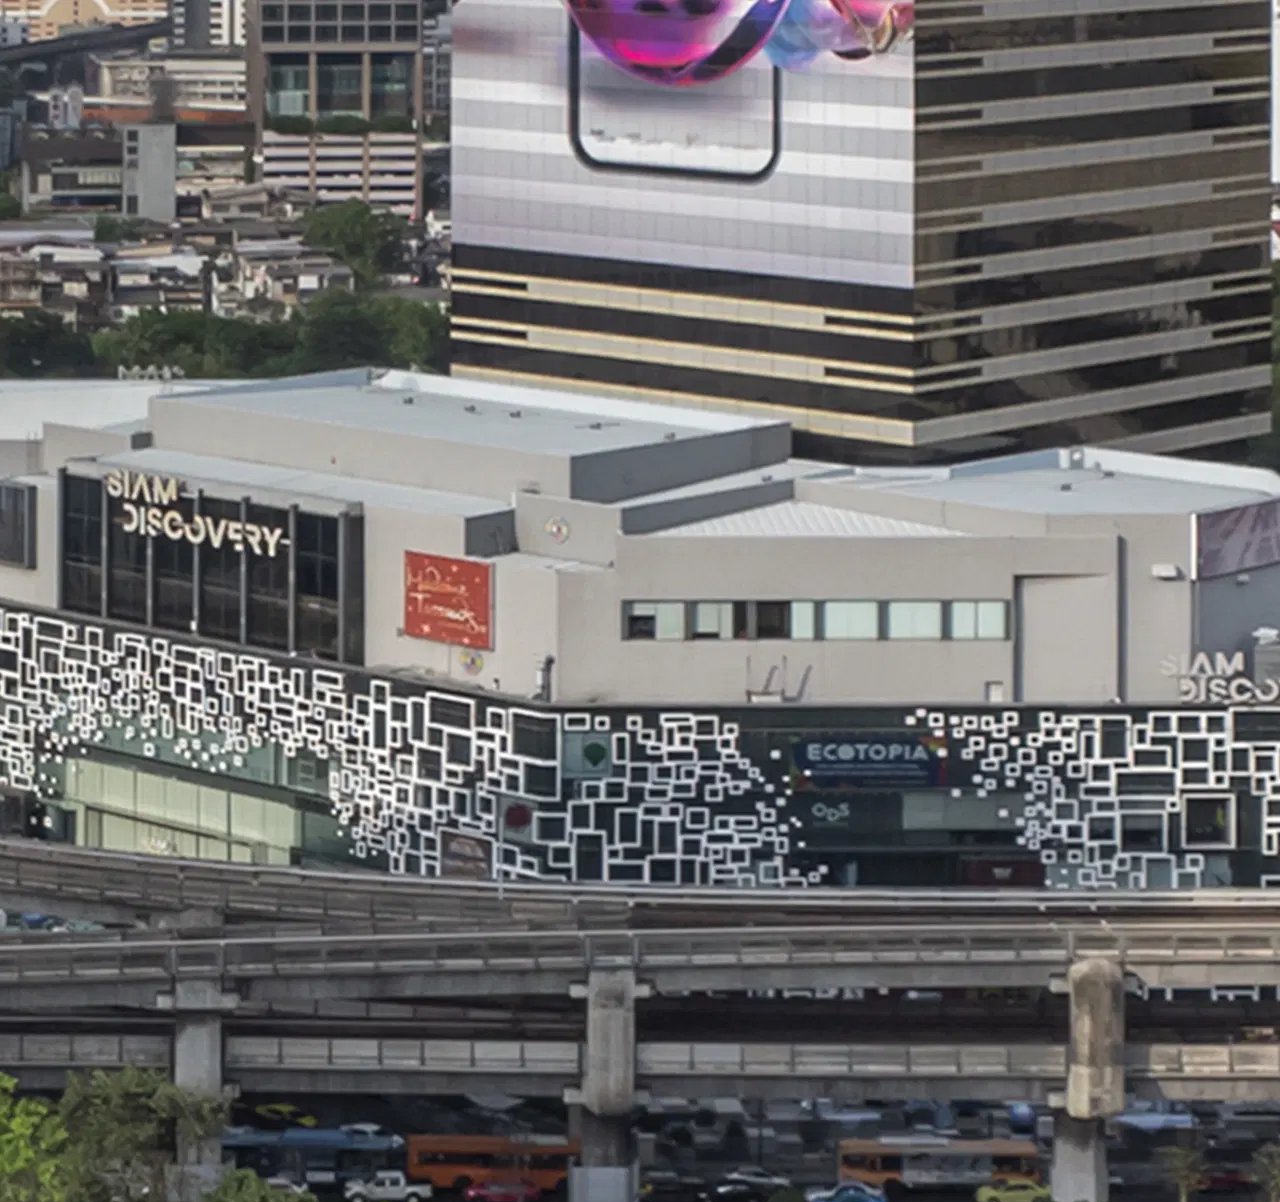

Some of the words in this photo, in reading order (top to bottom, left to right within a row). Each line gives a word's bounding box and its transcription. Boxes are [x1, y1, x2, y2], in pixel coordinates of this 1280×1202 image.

[107, 468, 179, 505] SIAM
[122, 502, 283, 558] DISCOVERY
[1159, 651, 1245, 677] SIAM
[806, 743, 929, 761] ECOTOPIA
